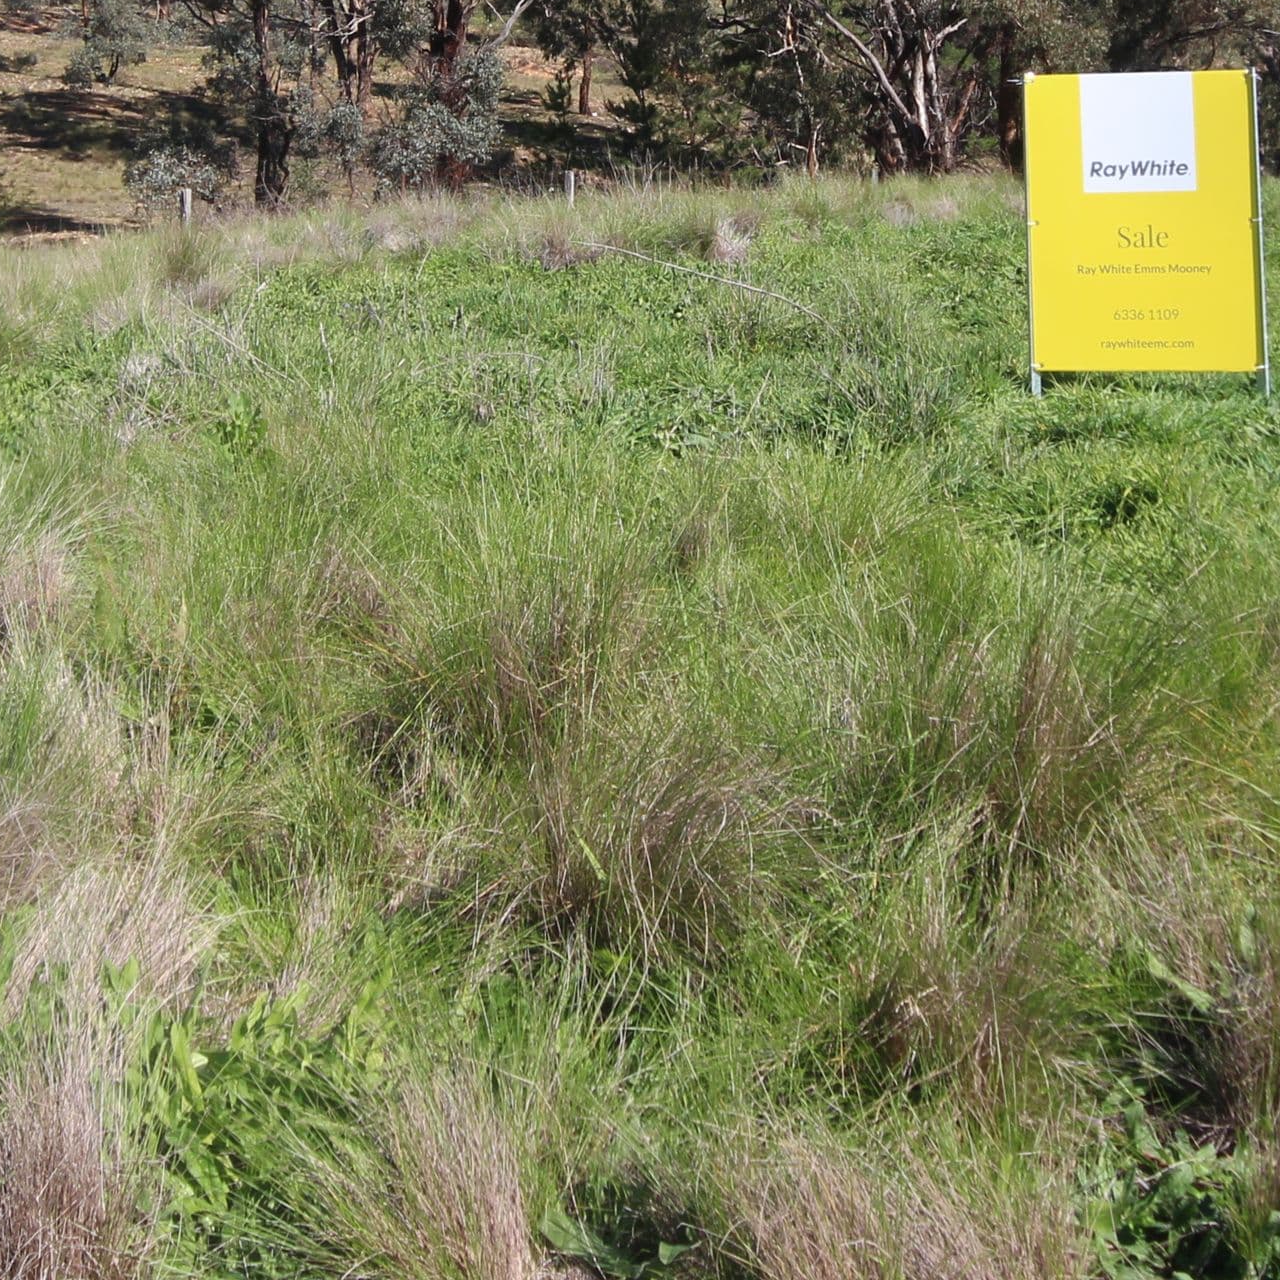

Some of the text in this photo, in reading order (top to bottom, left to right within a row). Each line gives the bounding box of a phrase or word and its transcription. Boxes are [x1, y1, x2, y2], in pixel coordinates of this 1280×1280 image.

[1117, 224, 1169, 248] Sale
[1077, 263, 1212, 275] Ray White Emms Mooney
[1113, 308, 1180, 321] 6336 1109
[1101, 338, 1195, 350] raywhiteemc.com
